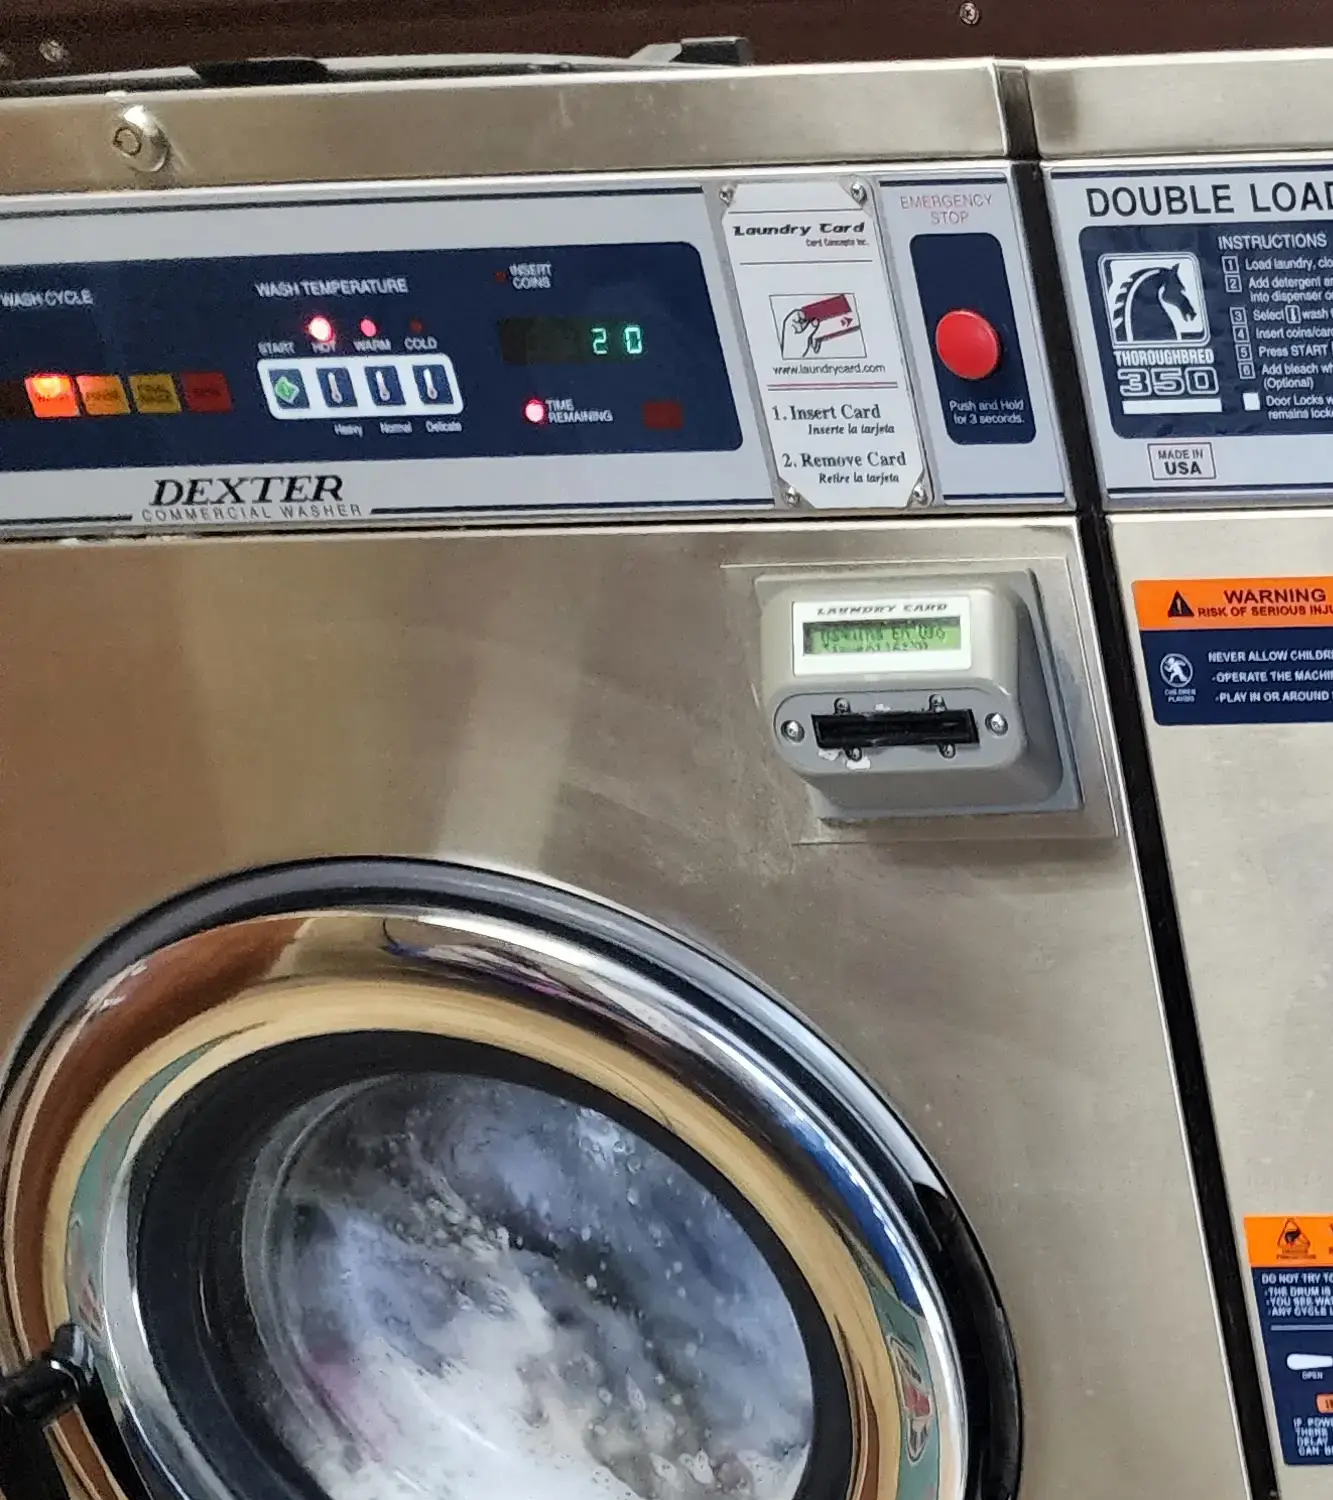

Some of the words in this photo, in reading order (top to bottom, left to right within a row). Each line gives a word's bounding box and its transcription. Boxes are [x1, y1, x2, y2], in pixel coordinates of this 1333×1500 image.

[899, 193, 992, 211] EMERGENCY
[1086, 184, 1234, 218] DOUBLE
[930, 211, 969, 225] STOP
[733, 223, 811, 236] Laundry
[819, 222, 865, 233] Card
[1218, 234, 1327, 250] INSTRUCTIONS
[1245, 259, 1271, 270] Load
[255, 282, 300, 297] WASH
[303, 278, 408, 296] TEMPERATURE
[591, 324, 642, 355] 20
[1113, 349, 1214, 366] THOROUGHBRED
[1258, 346, 1288, 357] Press
[1290, 345, 1328, 356] START
[772, 363, 885, 376] www.laundrycard.com
[1262, 365, 1282, 375] Add
[1285, 364, 1318, 374] bleach
[1118, 366, 1219, 396] 350
[1263, 376, 1314, 390] (Optional)
[545, 399, 574, 412] TIME
[773, 405, 787, 420] 1.
[789, 405, 836, 420] Insert
[841, 403, 881, 419] Card
[950, 400, 976, 411] Push
[979, 400, 998, 410] and
[1000, 399, 1024, 410] Hold
[548, 409, 613, 423] REMAINING
[954, 414, 966, 424] for
[969, 414, 977, 424] 3
[808, 423, 844, 435] Inserte
[848, 423, 858, 434] la
[861, 422, 895, 435] tarjeta
[782, 454, 796, 468] 2.
[801, 453, 862, 467] Remove
[867, 451, 906, 466] Card
[1157, 449, 1190, 461] MADE
[1192, 448, 1204, 459] IN
[1164, 461, 1201, 476] USA
[853, 472, 863, 483] la
[866, 472, 899, 484] tarjeta
[149, 474, 344, 506] DEXTER
[142, 507, 271, 523] COMMERCIAL
[280, 503, 362, 518] WASHER
[1224, 588, 1326, 604] WARNING
[816, 604, 895, 616] LAUNDRY
[903, 603, 948, 613] CARD
[1198, 605, 1227, 617] RISK
[1230, 605, 1247, 617] OF
[1251, 605, 1306, 616] SERIOUS
[1208, 651, 1245, 663] NEVER
[1248, 650, 1287, 662] ALLOW
[1271, 671, 1292, 682] THE
[1250, 692, 1260, 703] IN
[1263, 691, 1280, 702] OR
[1282, 690, 1329, 701] AROUND
